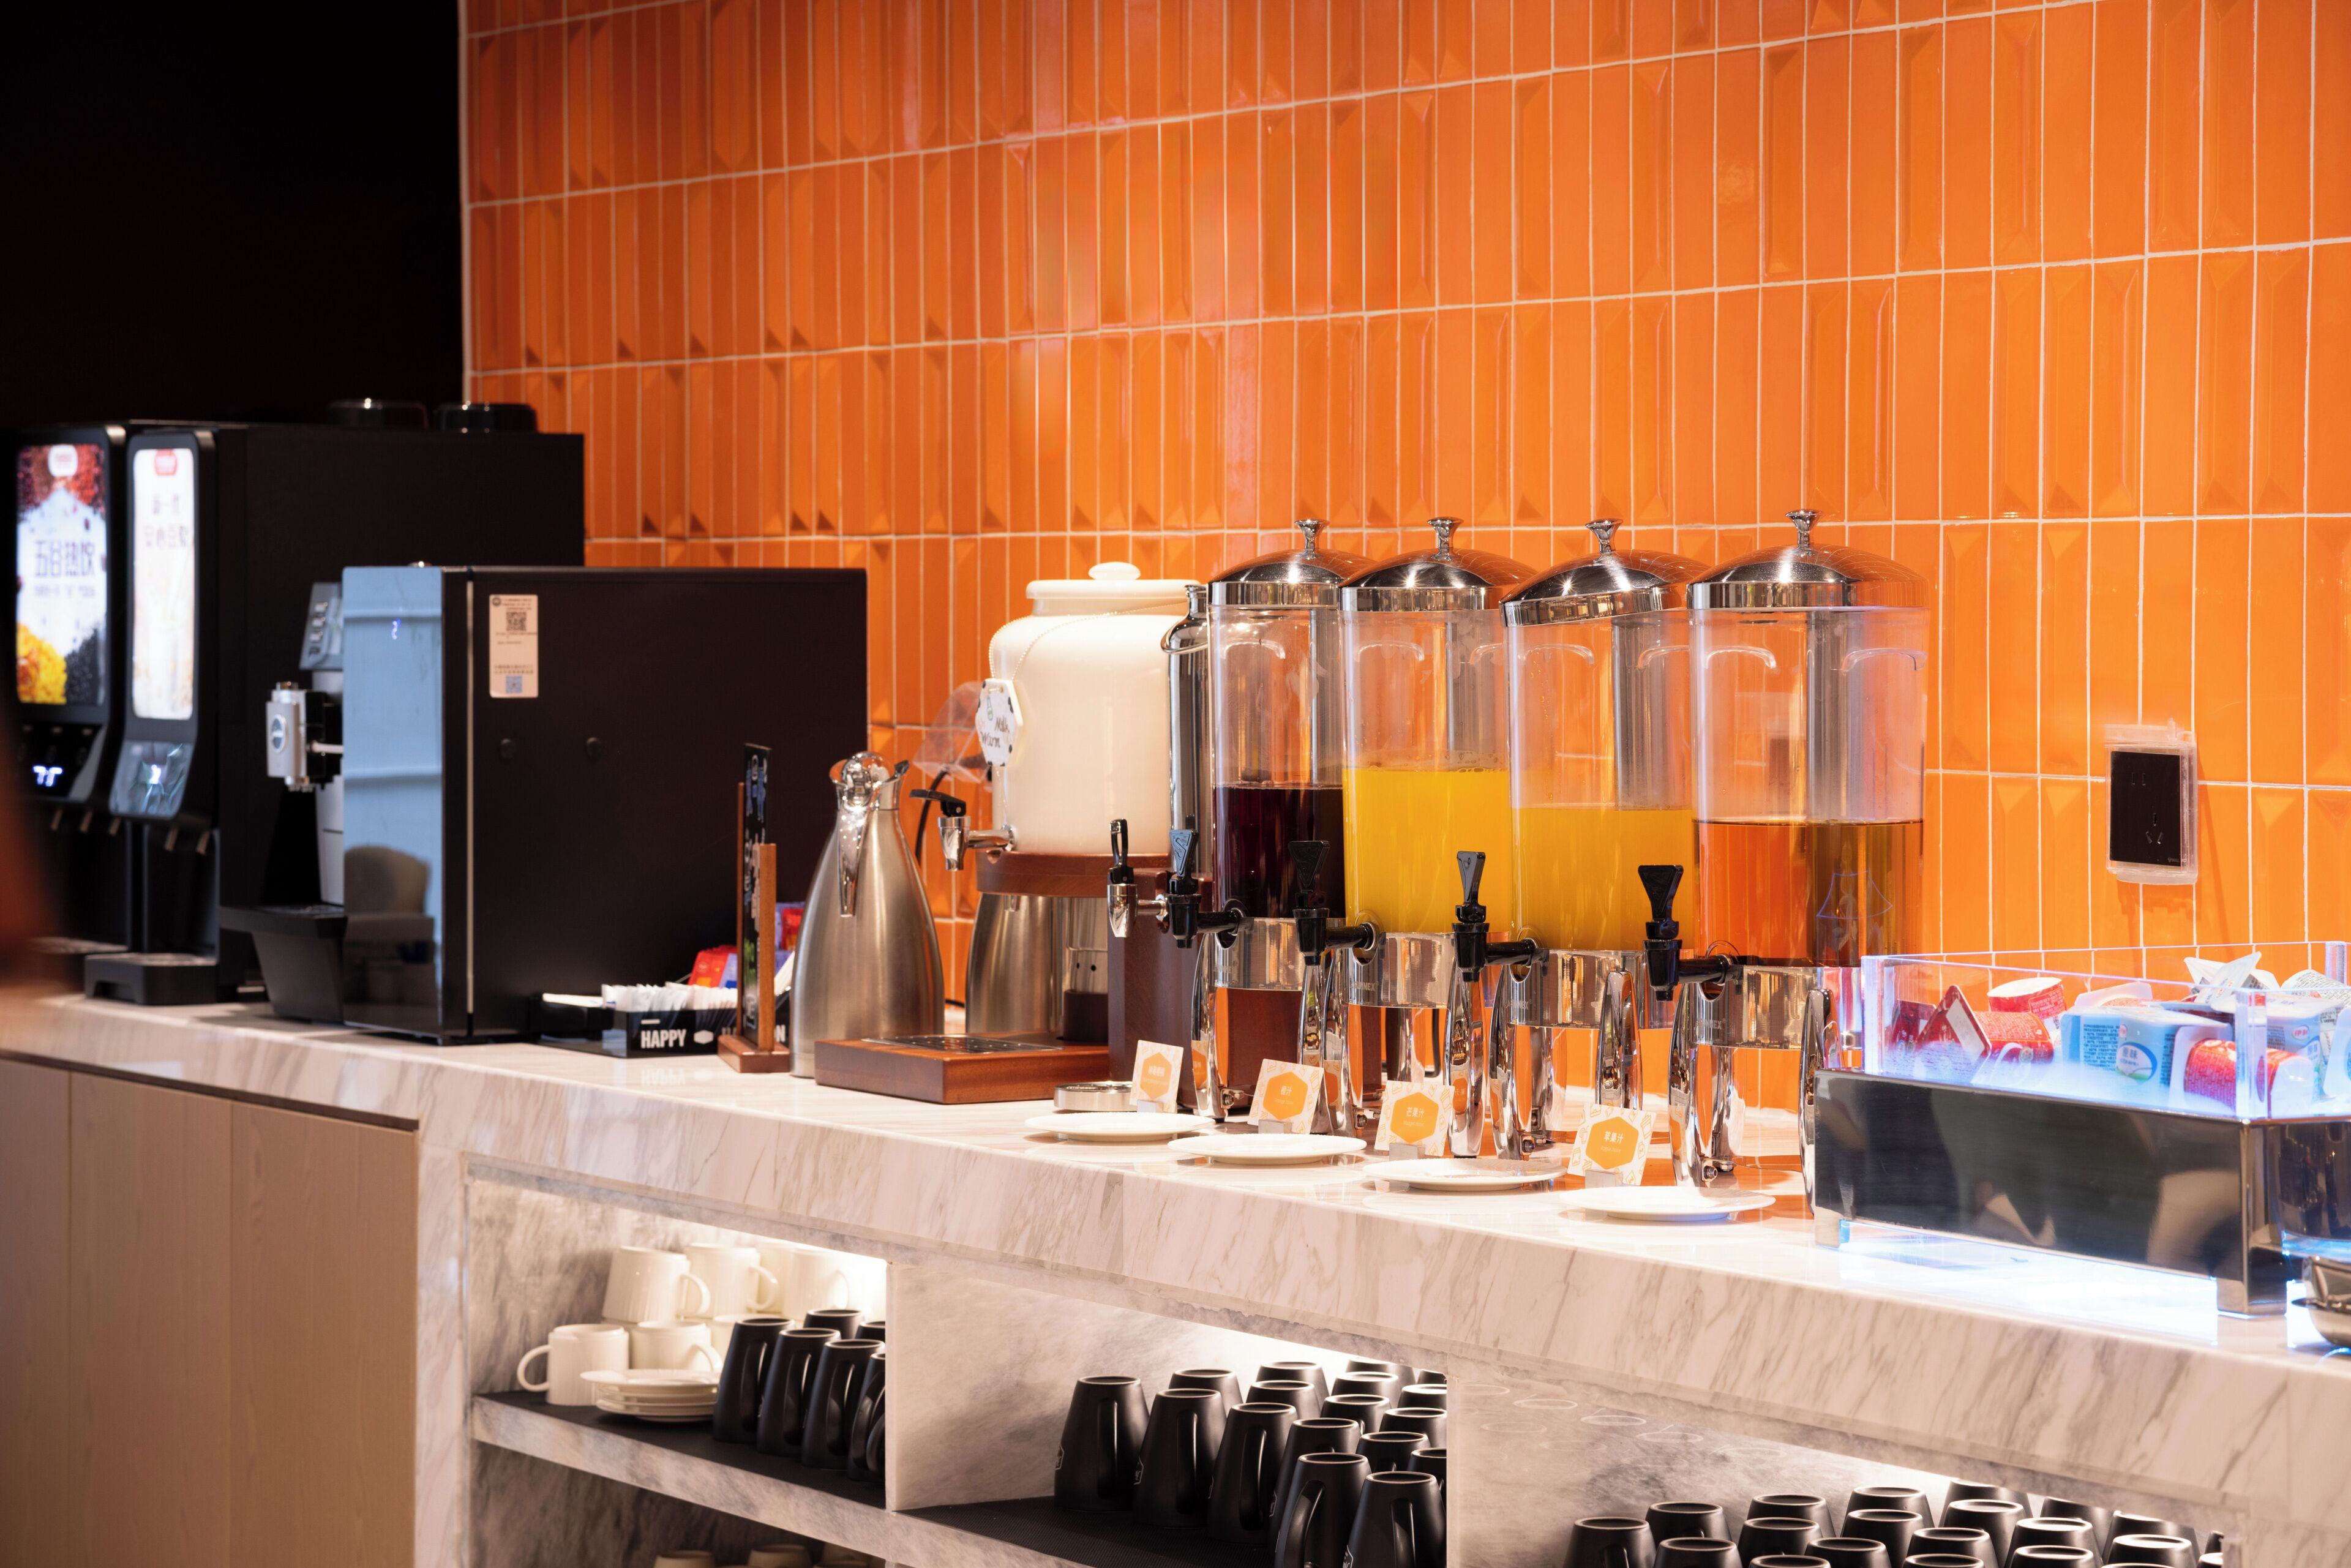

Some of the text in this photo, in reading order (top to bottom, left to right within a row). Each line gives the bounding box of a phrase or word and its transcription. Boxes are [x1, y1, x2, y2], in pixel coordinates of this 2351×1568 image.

[640, 1029, 686, 1049] HAPPY
[1406, 1106, 1425, 1118] 芒果汁
[1603, 1131, 1624, 1144] 苹果汁
